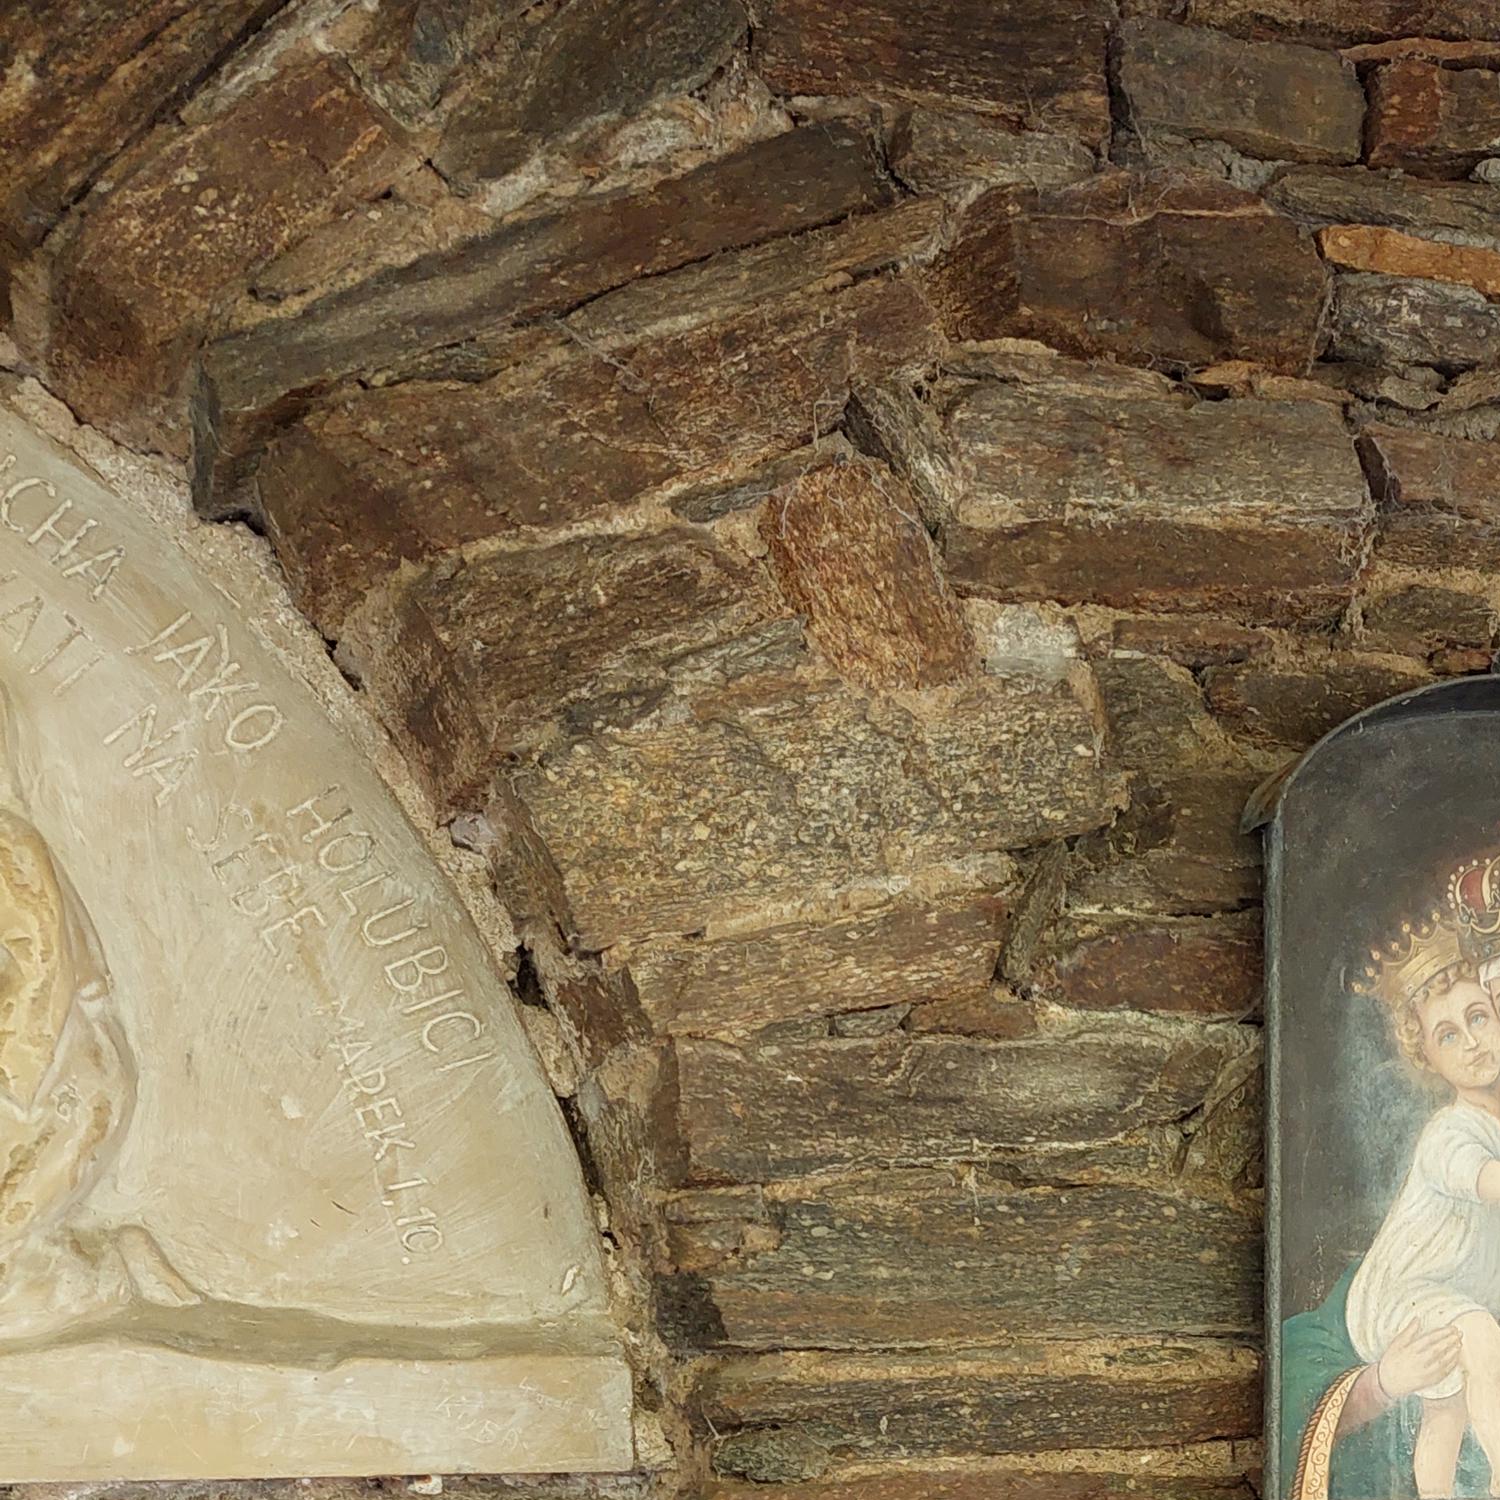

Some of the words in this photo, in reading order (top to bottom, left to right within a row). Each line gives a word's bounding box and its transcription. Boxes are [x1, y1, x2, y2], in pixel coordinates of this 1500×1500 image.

[0, 571, 102, 697] ATI
[103, 703, 199, 808] NA
[0, 454, 125, 602] CHA
[124, 610, 287, 750] JAKO
[286, 784, 495, 1073] HOLUBICI
